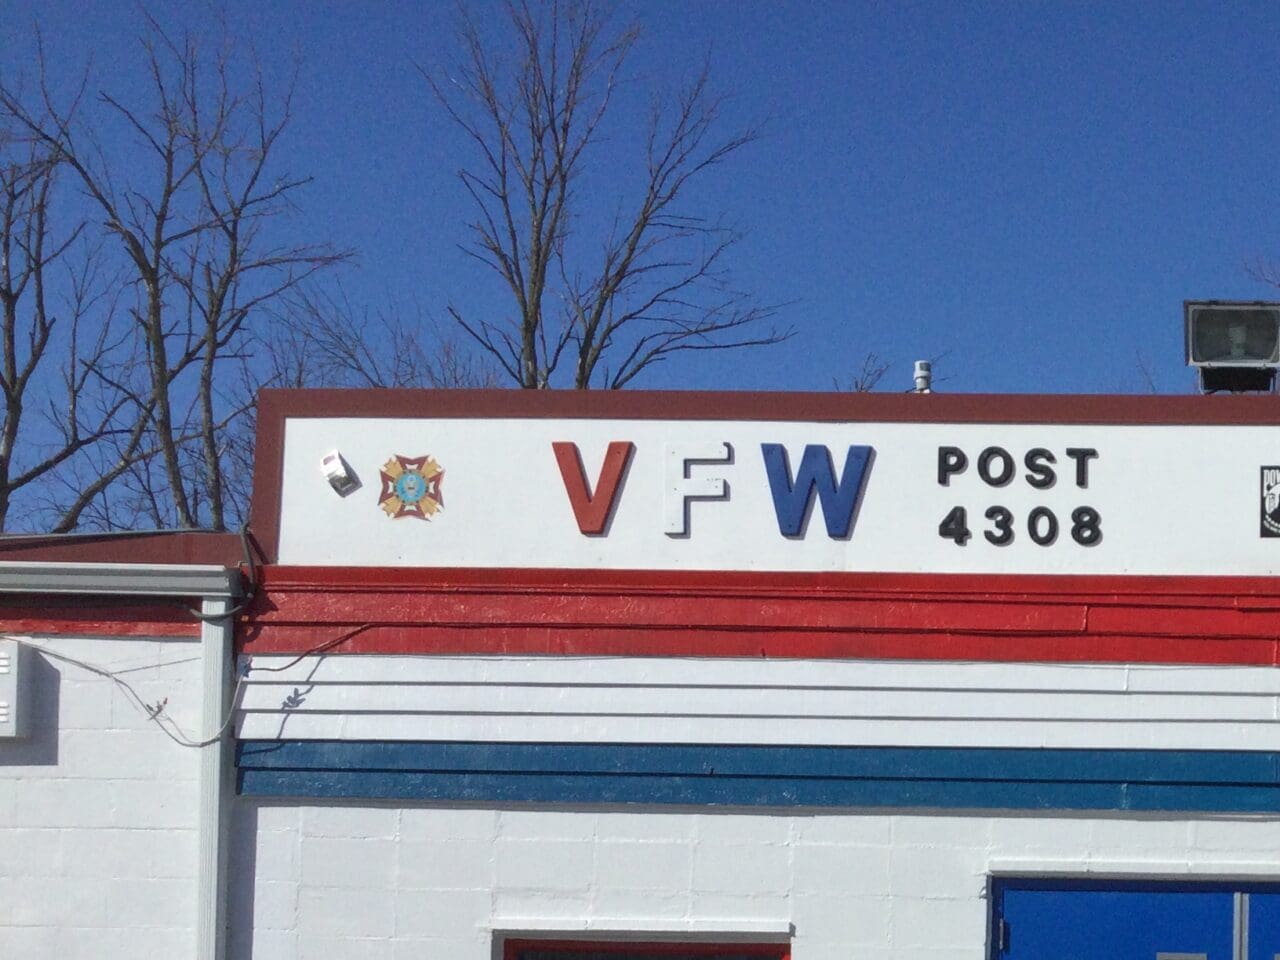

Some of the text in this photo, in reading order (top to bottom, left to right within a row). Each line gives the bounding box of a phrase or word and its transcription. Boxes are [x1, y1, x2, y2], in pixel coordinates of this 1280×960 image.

[937, 446, 1098, 489] POST
[552, 441, 876, 540] VFW
[938, 505, 1103, 547] 4308
